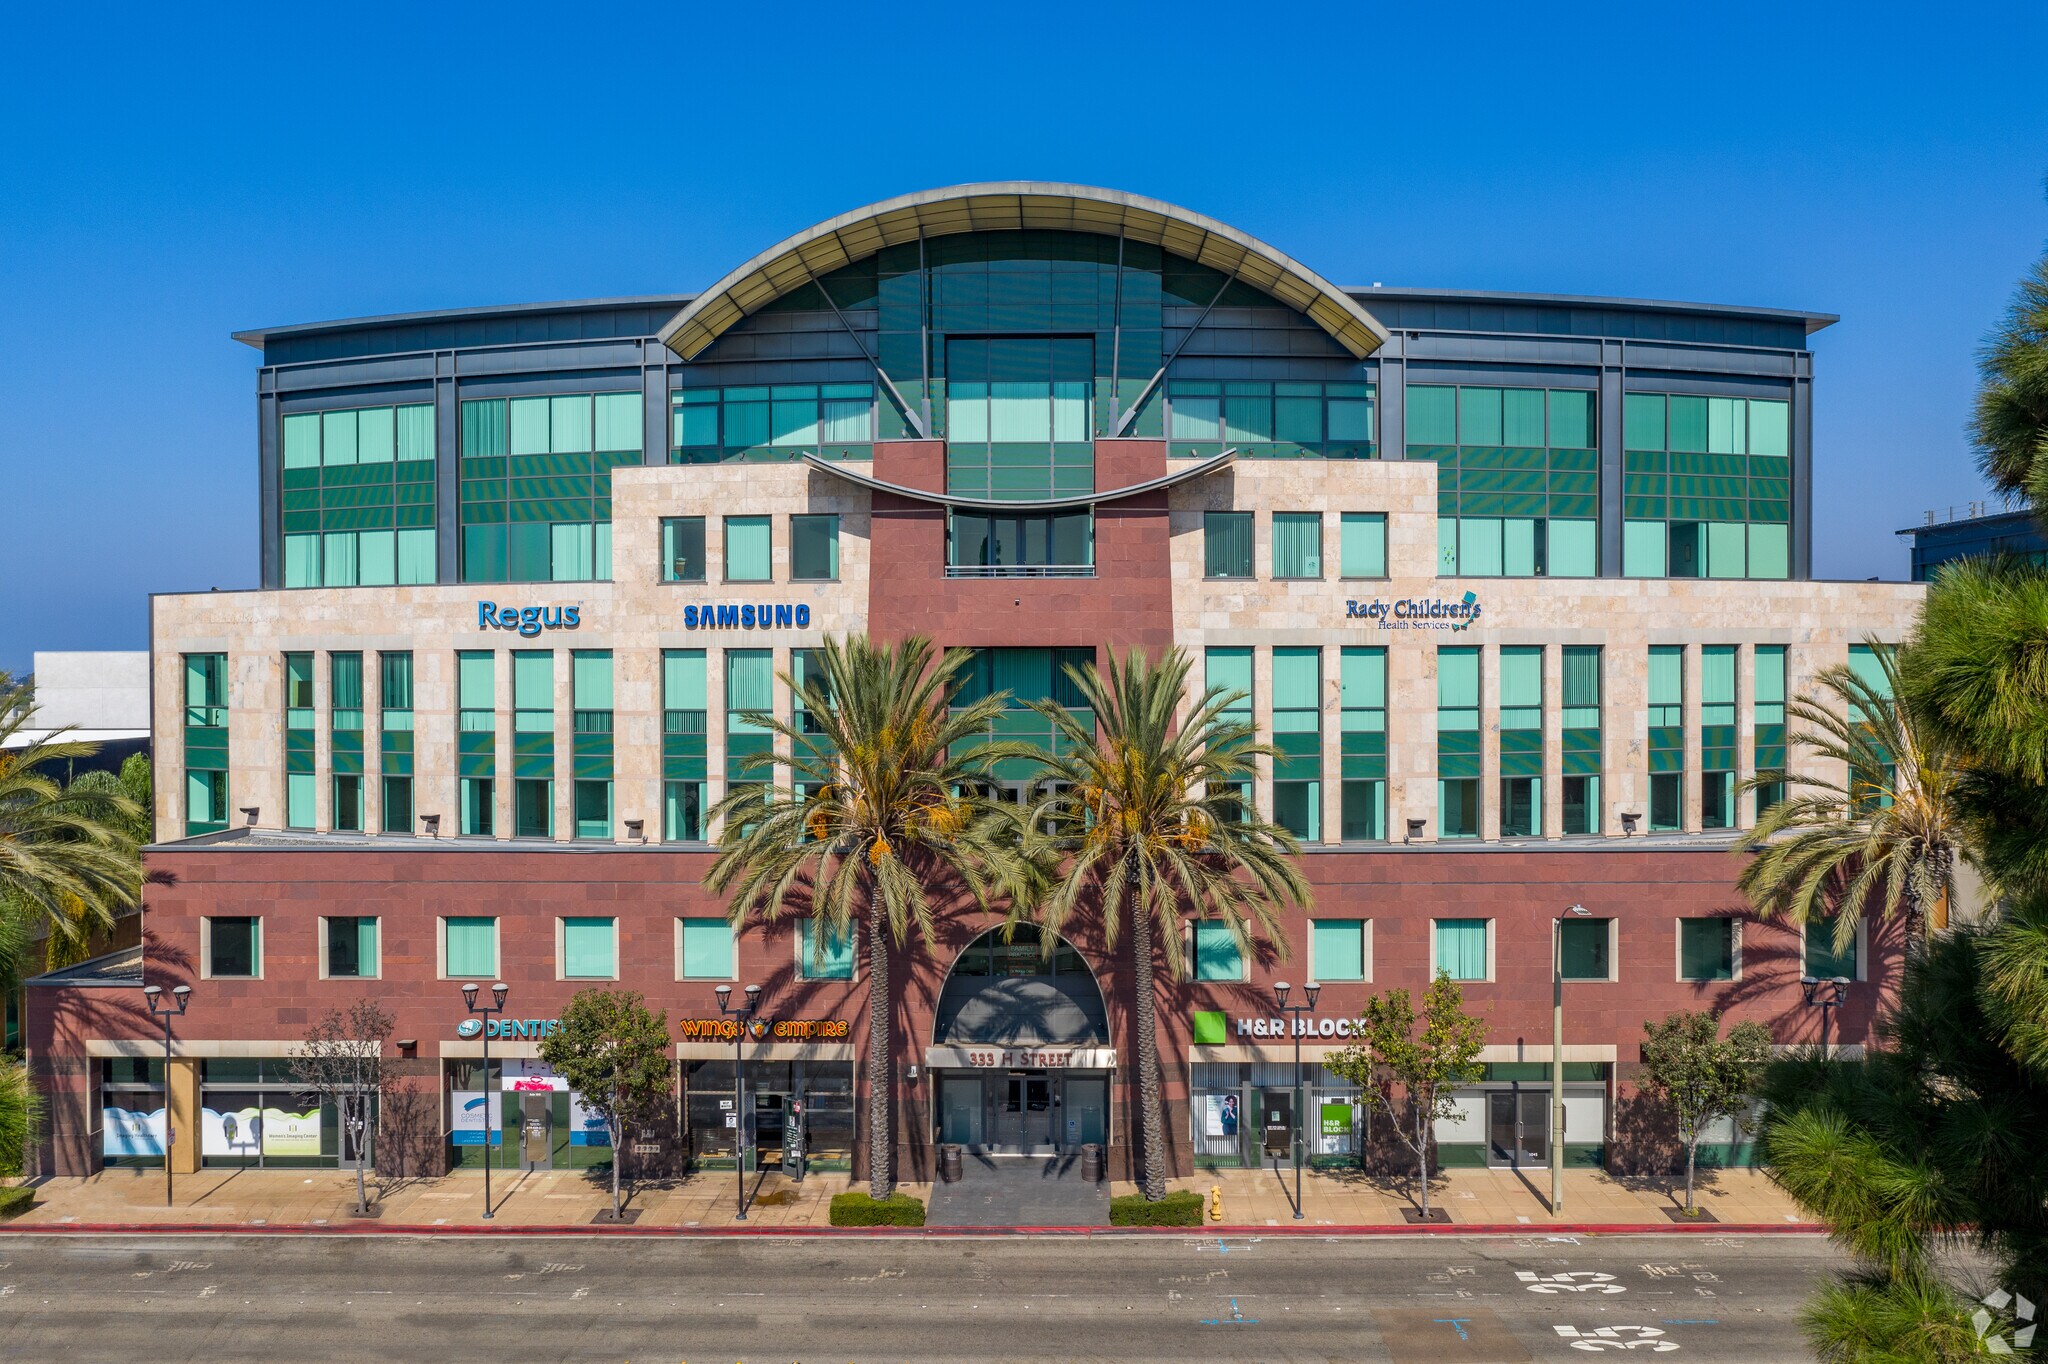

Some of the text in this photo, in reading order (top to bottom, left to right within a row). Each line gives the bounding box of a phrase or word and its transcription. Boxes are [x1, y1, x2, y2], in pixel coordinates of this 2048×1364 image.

[477, 600, 580, 634] Regus
[683, 603, 810, 627] SAMSUNG
[1346, 599, 1390, 620] Rady
[1378, 620, 1450, 629] Health Services
[1237, 1018, 1367, 1036] H&R BLOCK
[969, 1052, 1072, 1066] 333 H STREET
